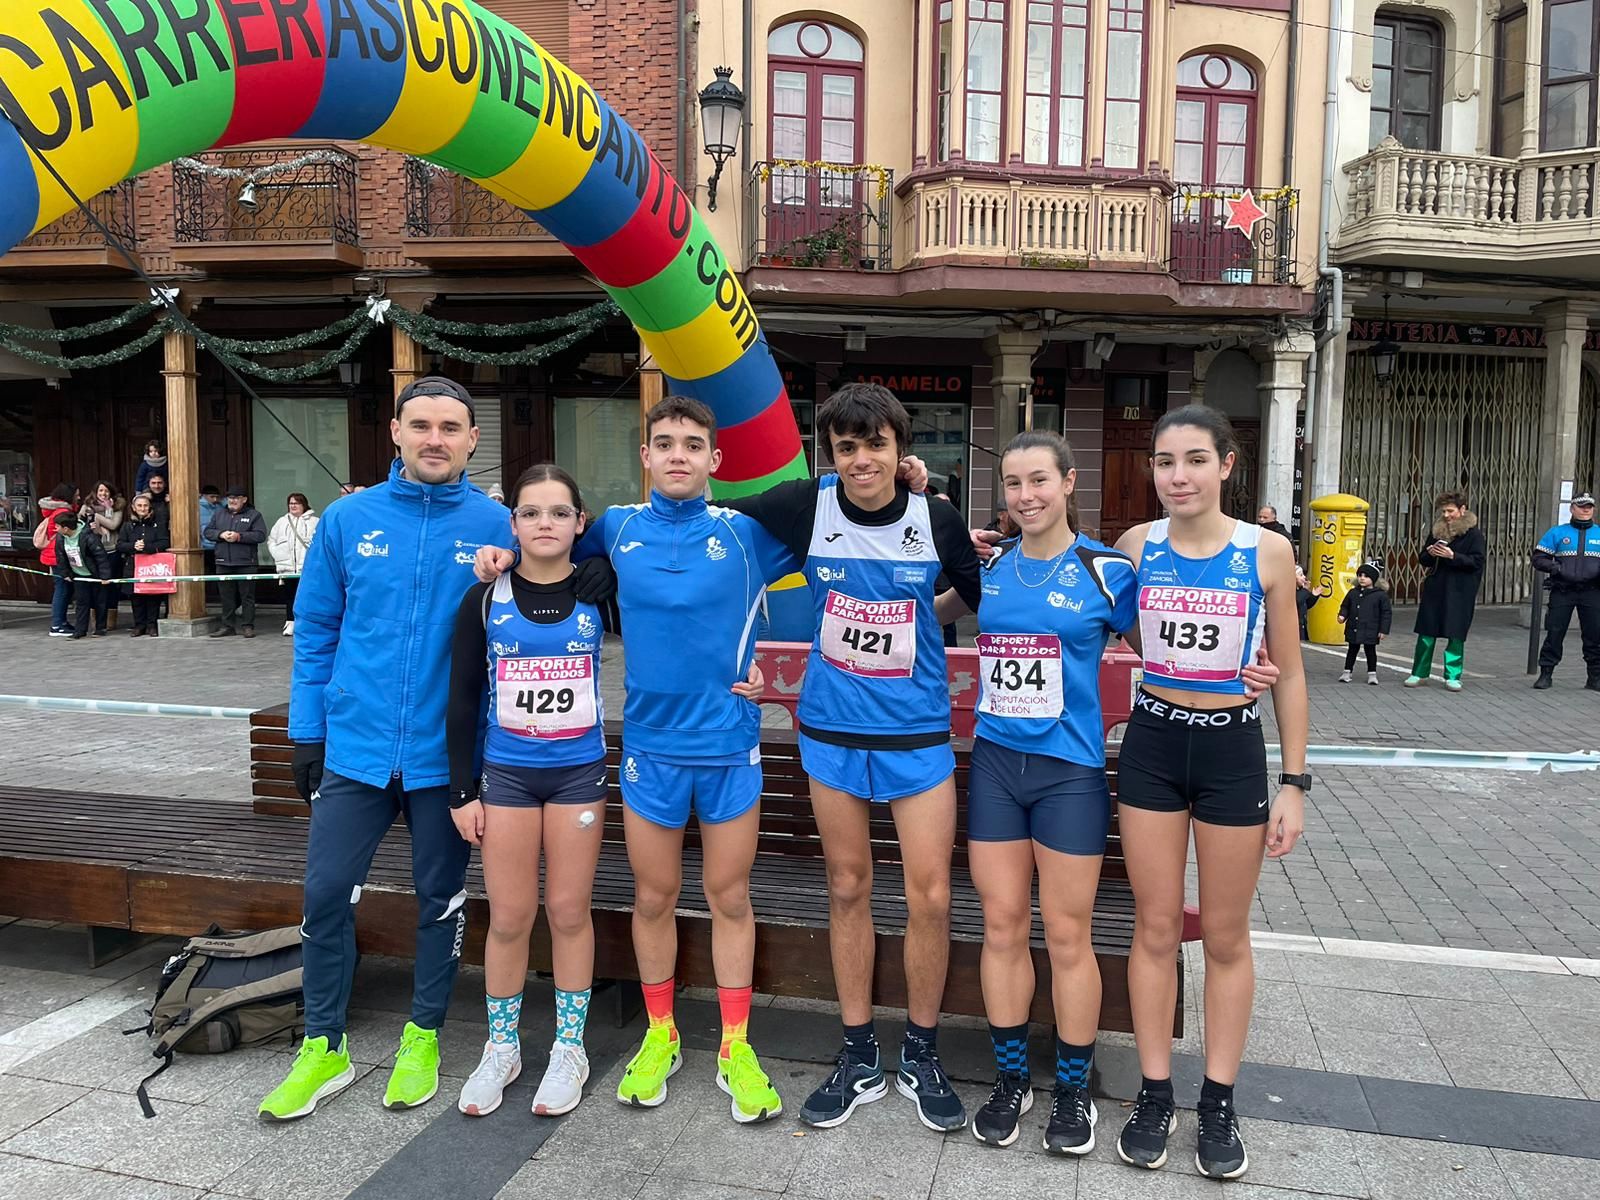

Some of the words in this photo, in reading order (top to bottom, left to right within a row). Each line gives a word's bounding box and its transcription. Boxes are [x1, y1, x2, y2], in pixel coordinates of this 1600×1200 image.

[1319, 521, 1337, 598] CORROS
[833, 595, 908, 615] DEPORTE
[1147, 588, 1238, 605] DEPORTE
[831, 606, 865, 621] PARA
[867, 613, 908, 624] TODOS
[1146, 599, 1184, 612] PARA
[1186, 602, 1238, 615] TODOS
[841, 626, 893, 656] 421
[991, 636, 1038, 645] DEPORTE
[1159, 620, 1220, 652] 433
[981, 645, 1006, 654] PARA
[1011, 647, 1057, 656] TODOS
[505, 657, 586, 671] DEPORTE
[505, 671, 540, 681] PARA
[543, 669, 586, 680] TODOS
[990, 659, 1046, 691] 434
[515, 687, 575, 714] 429
[1169, 708, 1232, 727] PRO
